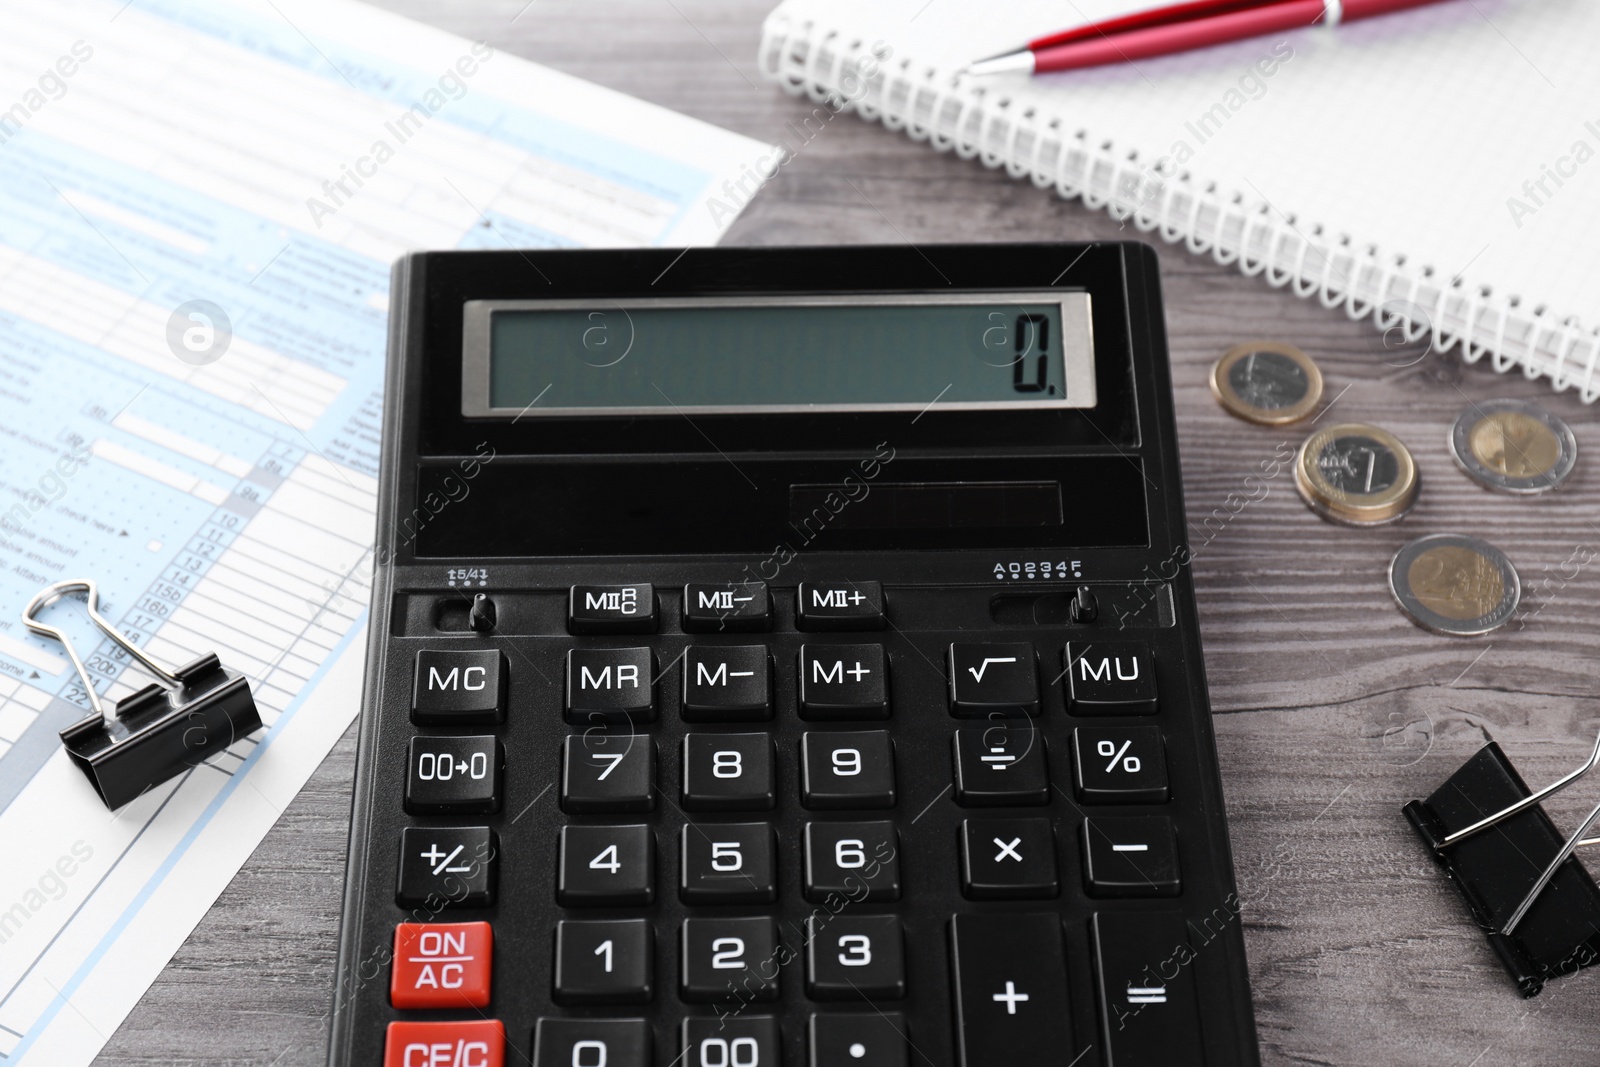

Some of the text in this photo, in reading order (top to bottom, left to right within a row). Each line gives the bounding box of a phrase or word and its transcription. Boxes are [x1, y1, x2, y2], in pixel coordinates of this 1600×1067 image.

[220, 514, 239, 529] 10
[207, 529, 224, 543] 11
[196, 542, 215, 557] 12
[184, 556, 203, 571] 13
[172, 571, 190, 585] 14
[155, 583, 181, 601] 15b
[142, 598, 168, 616] 16b
[133, 614, 154, 629] 17
[108, 644, 127, 660] 19
[88, 656, 117, 676] 20b
[428, 666, 487, 692] MC
[581, 664, 639, 690] MR
[1080, 656, 1140, 682] MU
[66, 688, 88, 705] 22
[592, 753, 623, 781] 7
[712, 750, 743, 779] 8
[831, 748, 861, 776] 9
[1097, 740, 1141, 773] %
[589, 844, 621, 874] 4
[711, 841, 743, 871] 5
[835, 839, 865, 869] 6
[419, 931, 466, 956] ON
[594, 940, 613, 973] 1
[712, 937, 745, 969] 2
[838, 934, 872, 966] 3
[415, 963, 464, 989] AC
[403, 1039, 489, 1067] CE/C
[572, 1040, 607, 1067] 0
[701, 1037, 758, 1067] 00
